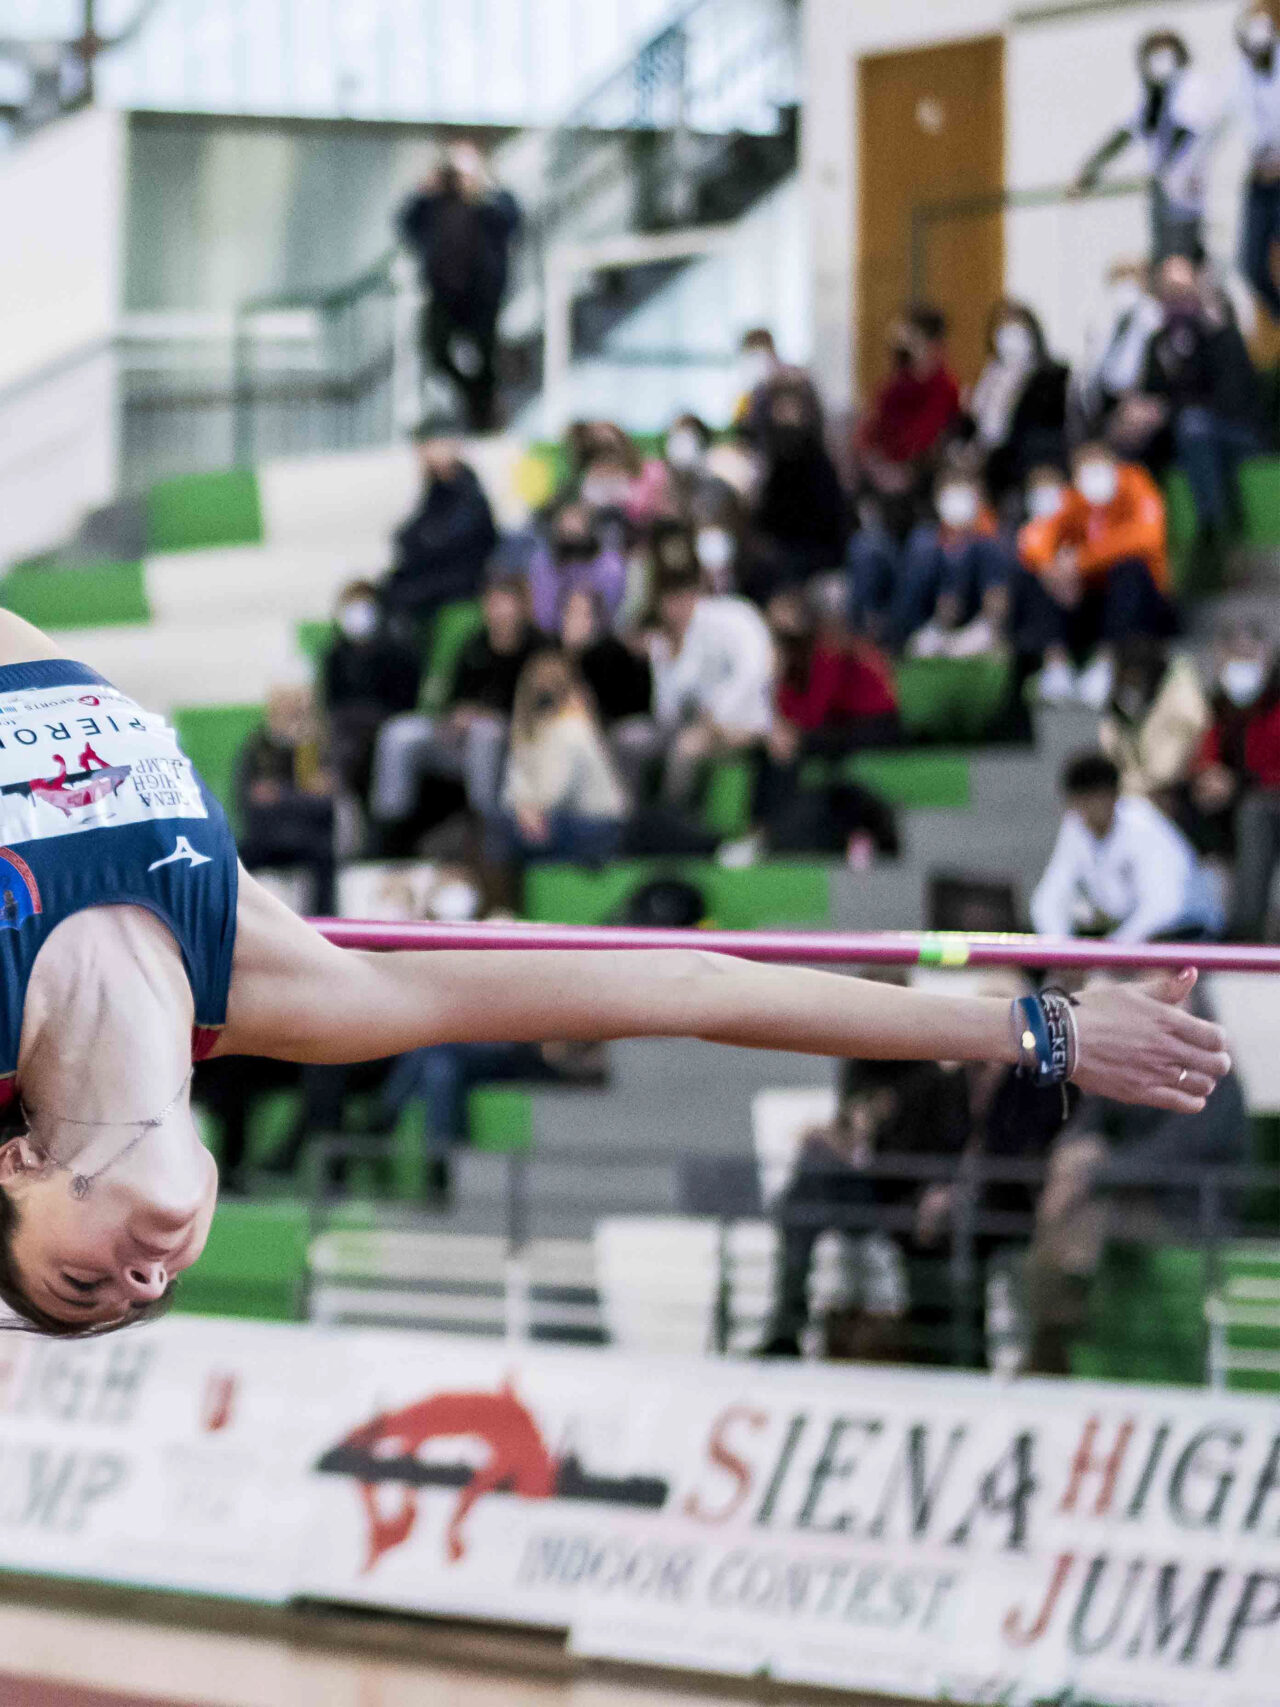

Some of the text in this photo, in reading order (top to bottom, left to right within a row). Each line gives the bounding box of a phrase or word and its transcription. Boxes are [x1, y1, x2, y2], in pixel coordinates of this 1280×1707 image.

[684, 1405, 1038, 1553] SIENA
[517, 1536, 958, 1632] INDOOR CONTEST
[999, 1551, 1280, 1668] JUMP
